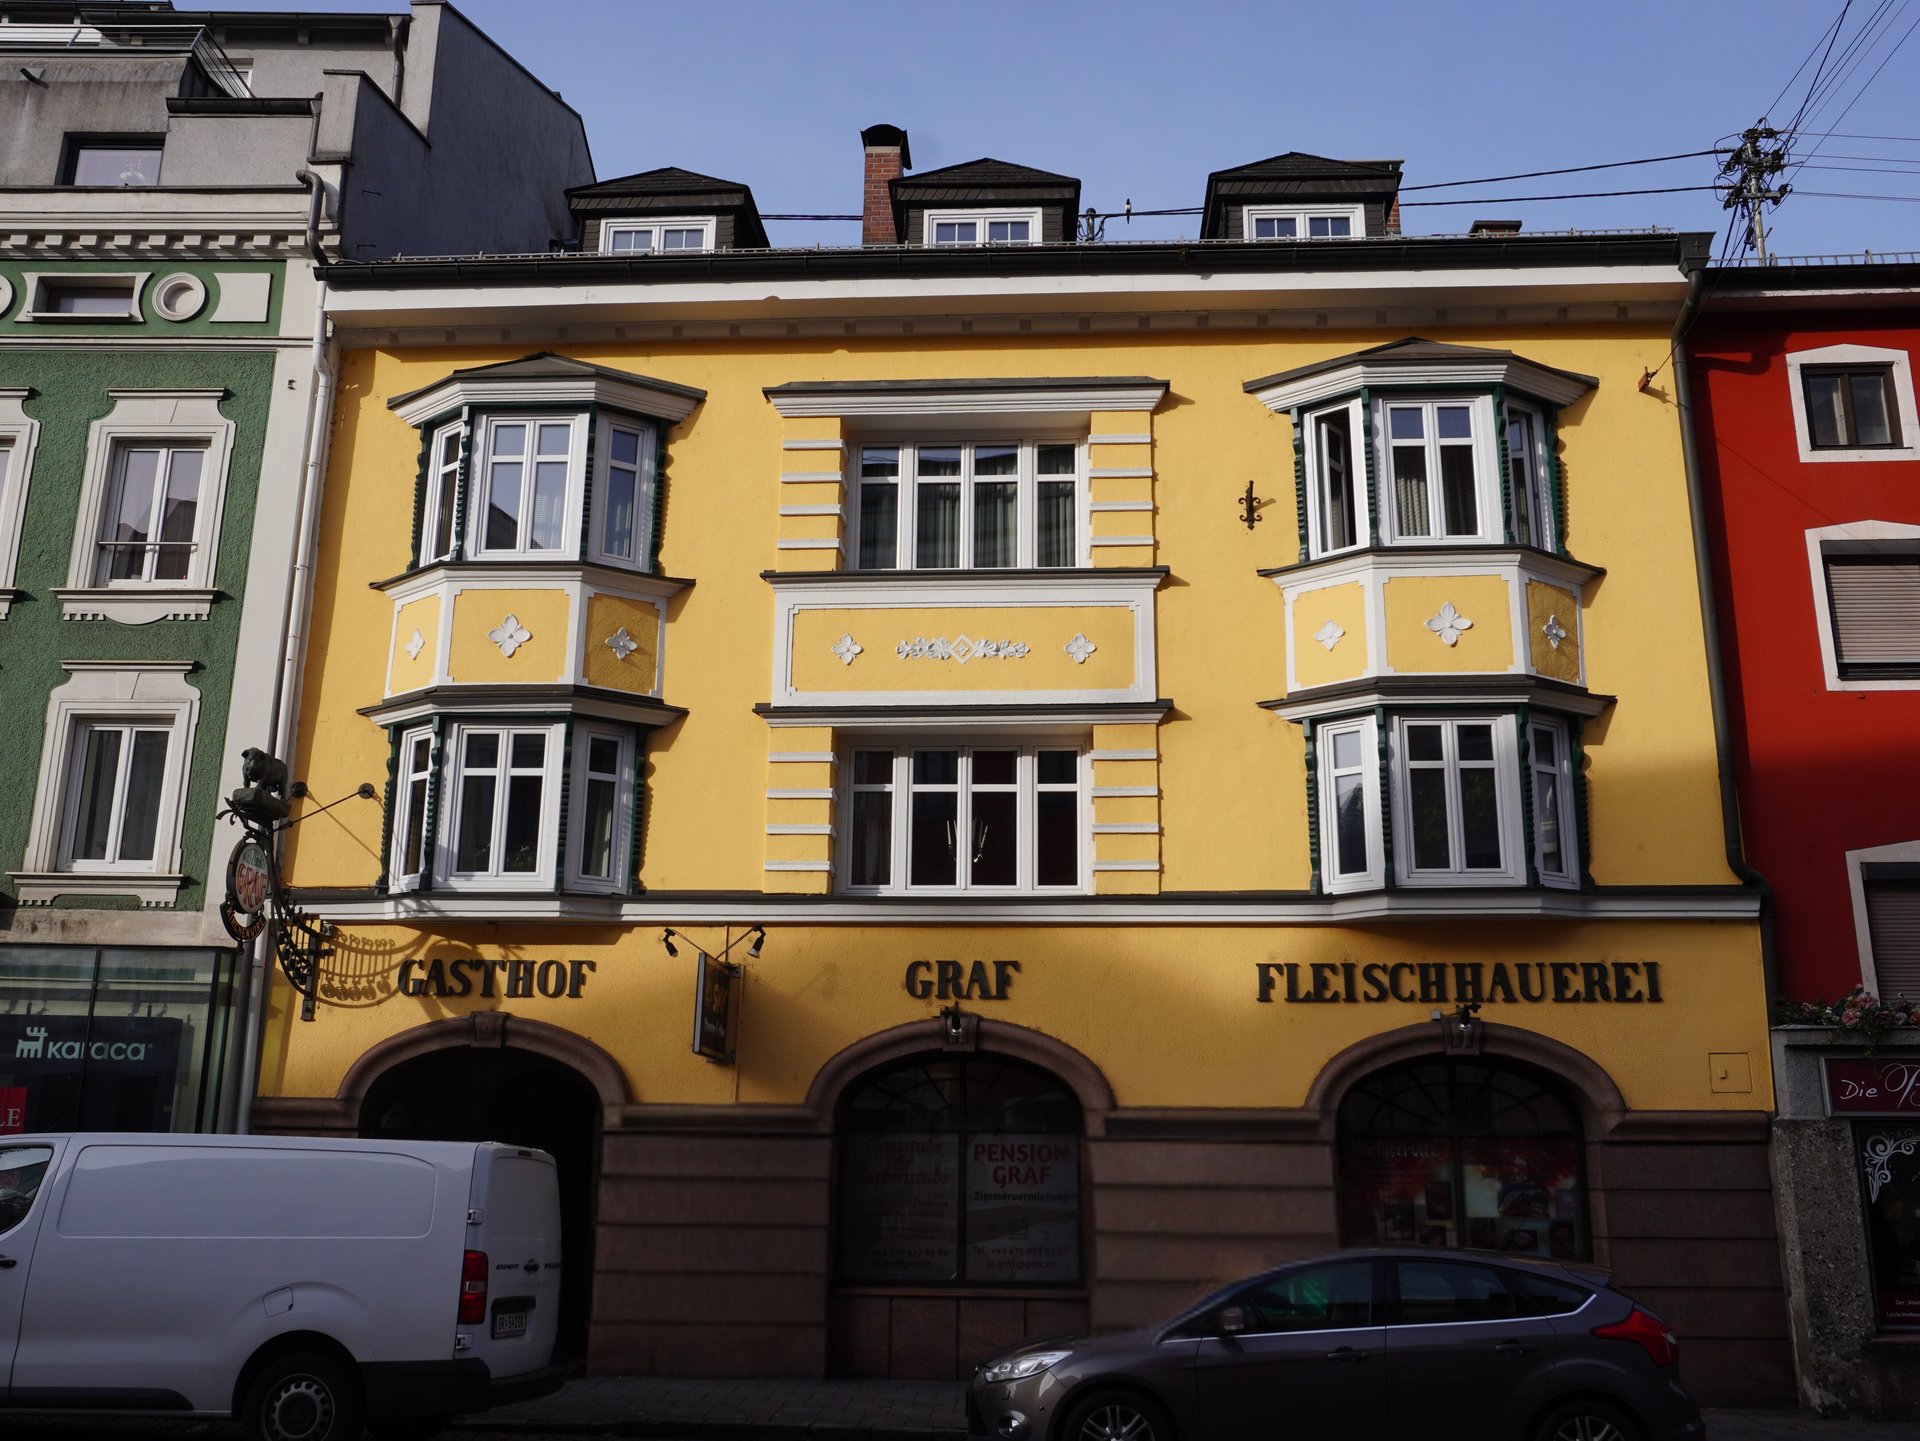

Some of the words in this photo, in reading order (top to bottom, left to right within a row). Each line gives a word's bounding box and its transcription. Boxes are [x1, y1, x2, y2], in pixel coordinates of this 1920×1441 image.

[398, 959, 596, 999] GASTHOF
[906, 960, 1021, 1000] GRAF
[1256, 962, 1663, 1003] FLEISCHHAUEREI
[1840, 1079, 1879, 1100] Die
[974, 1144, 1068, 1162] PENSION
[993, 1166, 1052, 1189] GRAF
